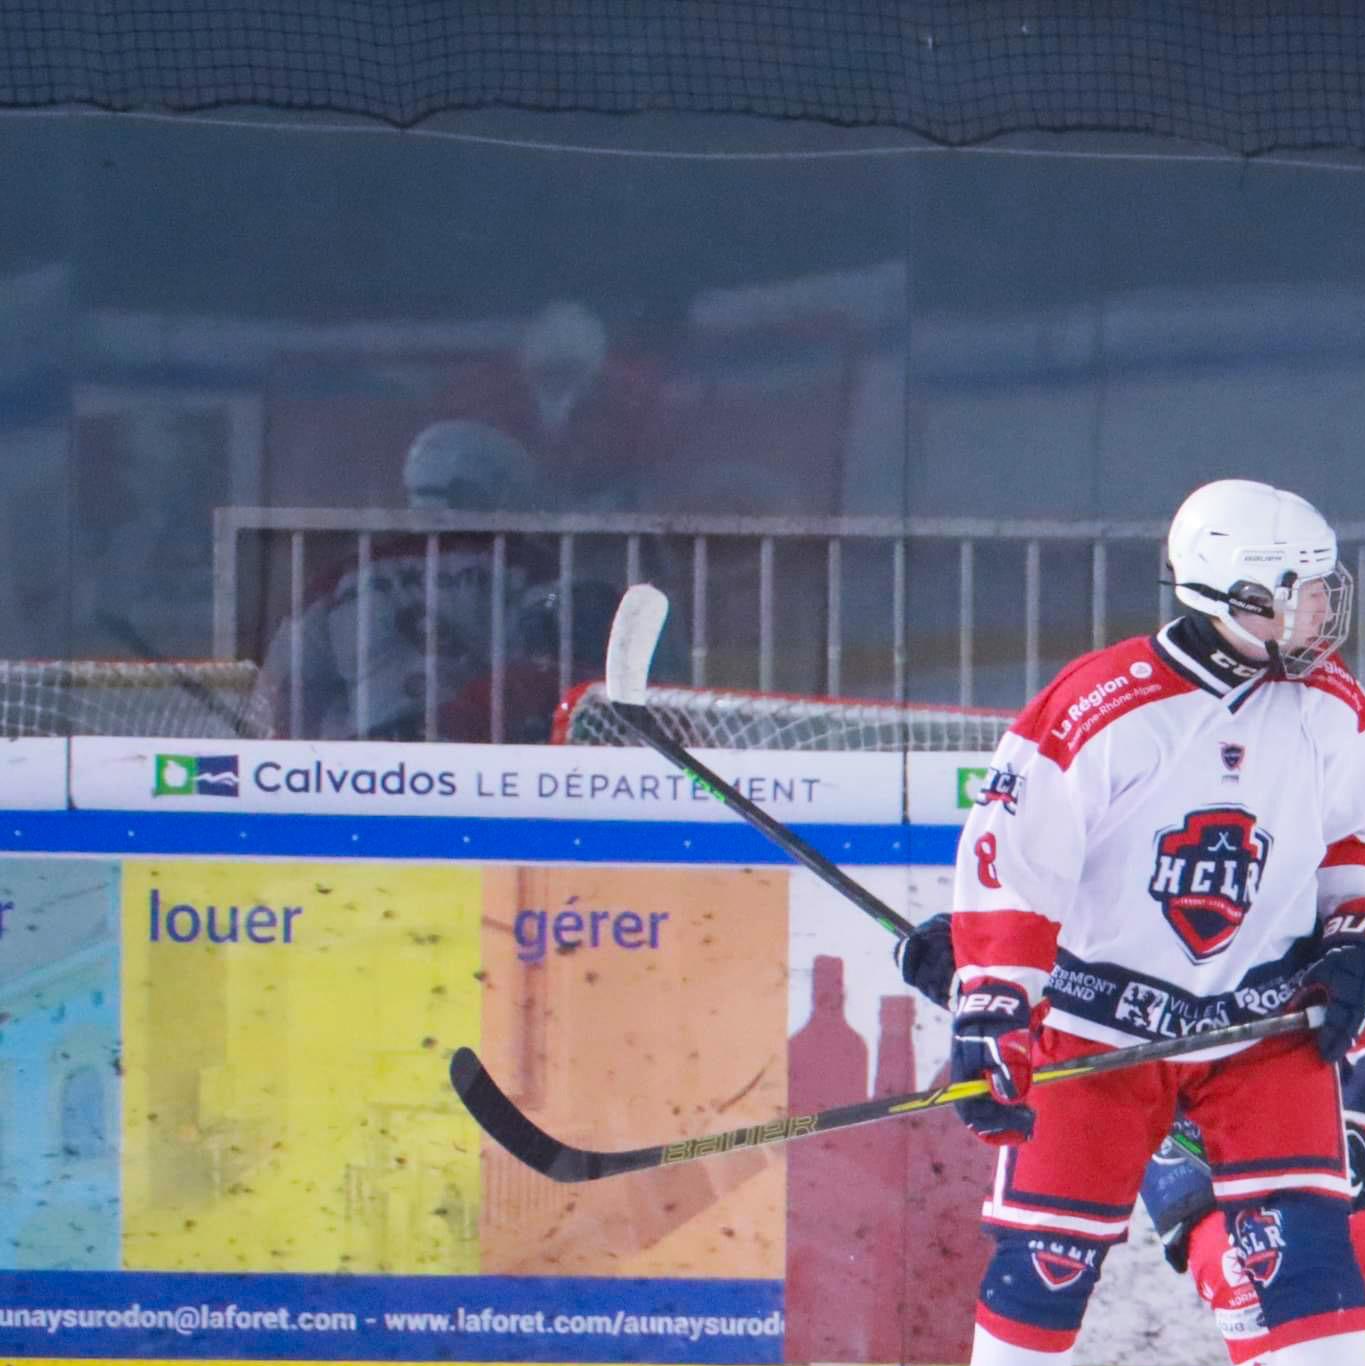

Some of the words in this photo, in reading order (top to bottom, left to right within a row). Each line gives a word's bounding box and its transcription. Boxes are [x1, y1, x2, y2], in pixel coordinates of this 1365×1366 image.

[1210, 649, 1259, 678] CC
[1051, 719, 1072, 740] La
[1068, 676, 1129, 721] Région
[253, 760, 457, 797] Calvados
[475, 773, 519, 799] LE
[974, 831, 1002, 889] 8
[1151, 855, 1260, 905] HCLR
[148, 888, 304, 945] louer
[513, 896, 669, 963] gérer
